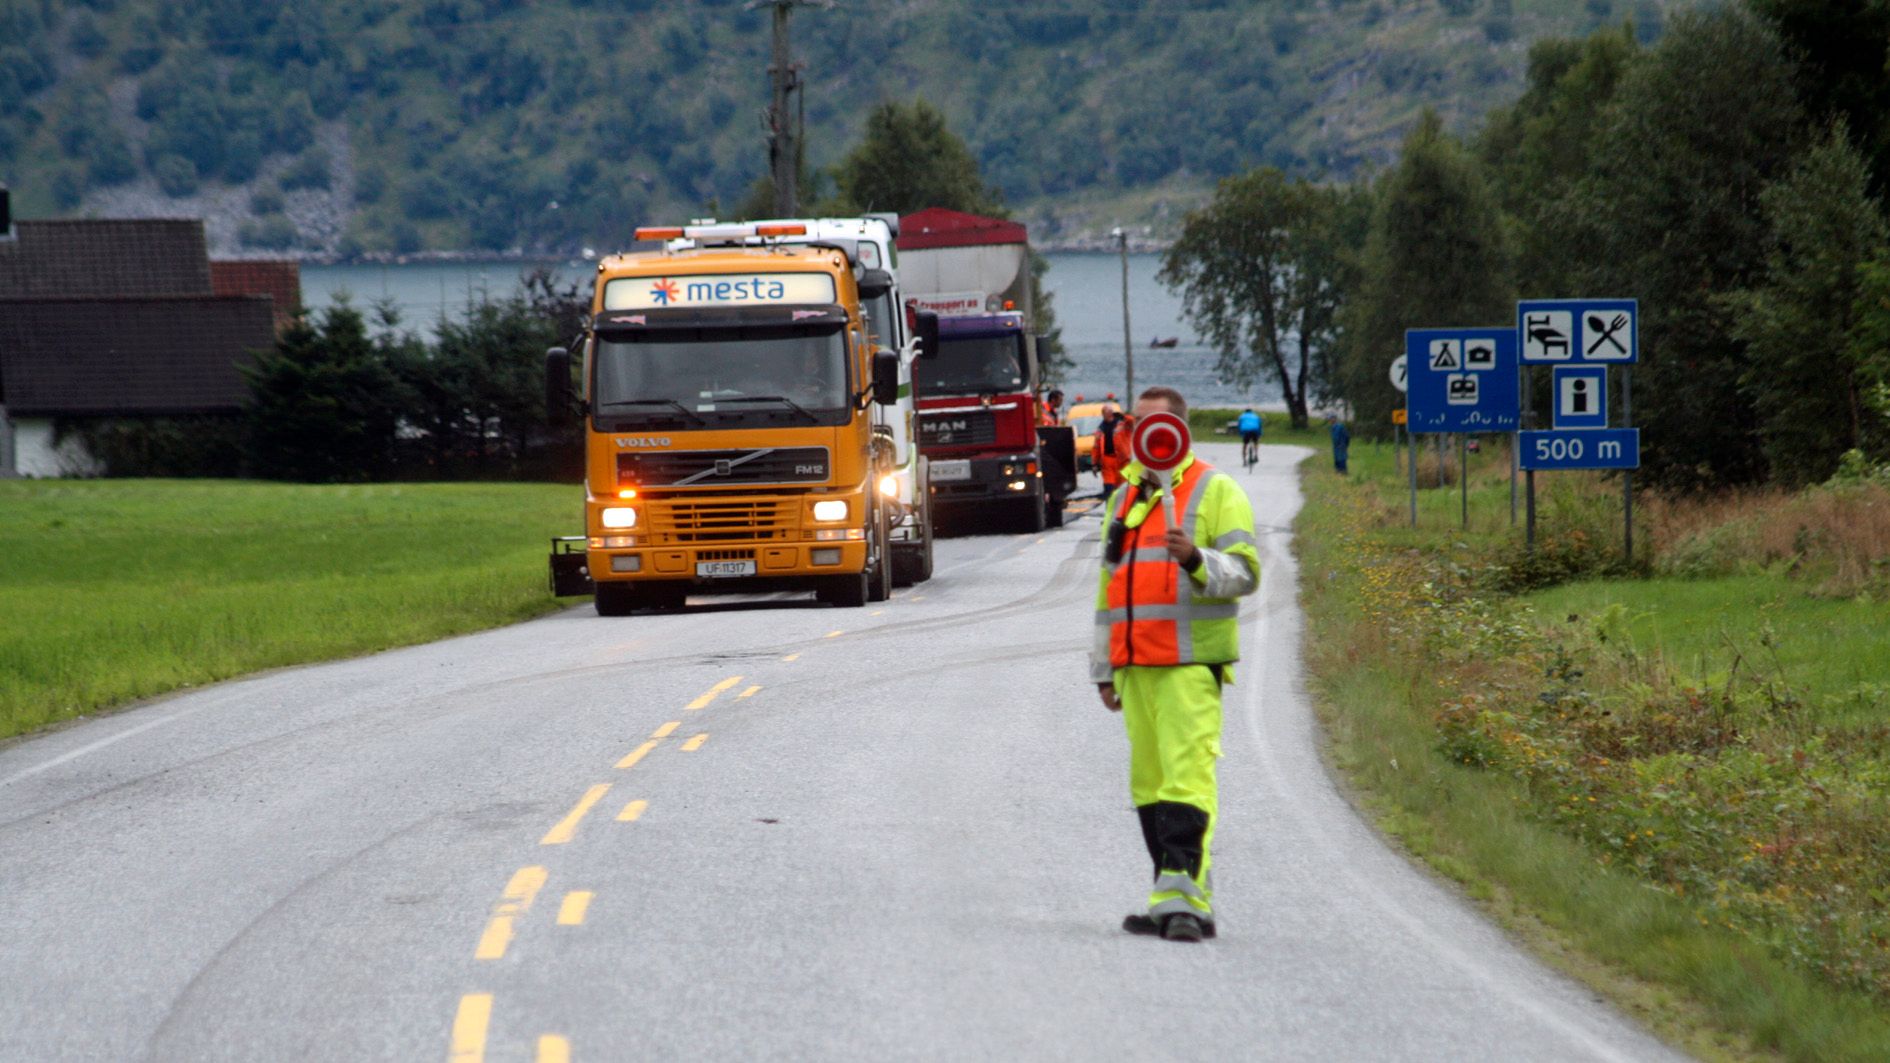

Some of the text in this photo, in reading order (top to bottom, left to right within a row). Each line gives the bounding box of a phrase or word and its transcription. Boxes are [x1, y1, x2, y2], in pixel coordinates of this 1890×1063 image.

[687, 277, 785, 301] mesta
[1398, 364, 1408, 382] 7
[922, 419, 966, 432] MAN
[614, 436, 672, 448] VOLVO
[1535, 438, 1621, 460] 500 m
[795, 464, 823, 475] FM12
